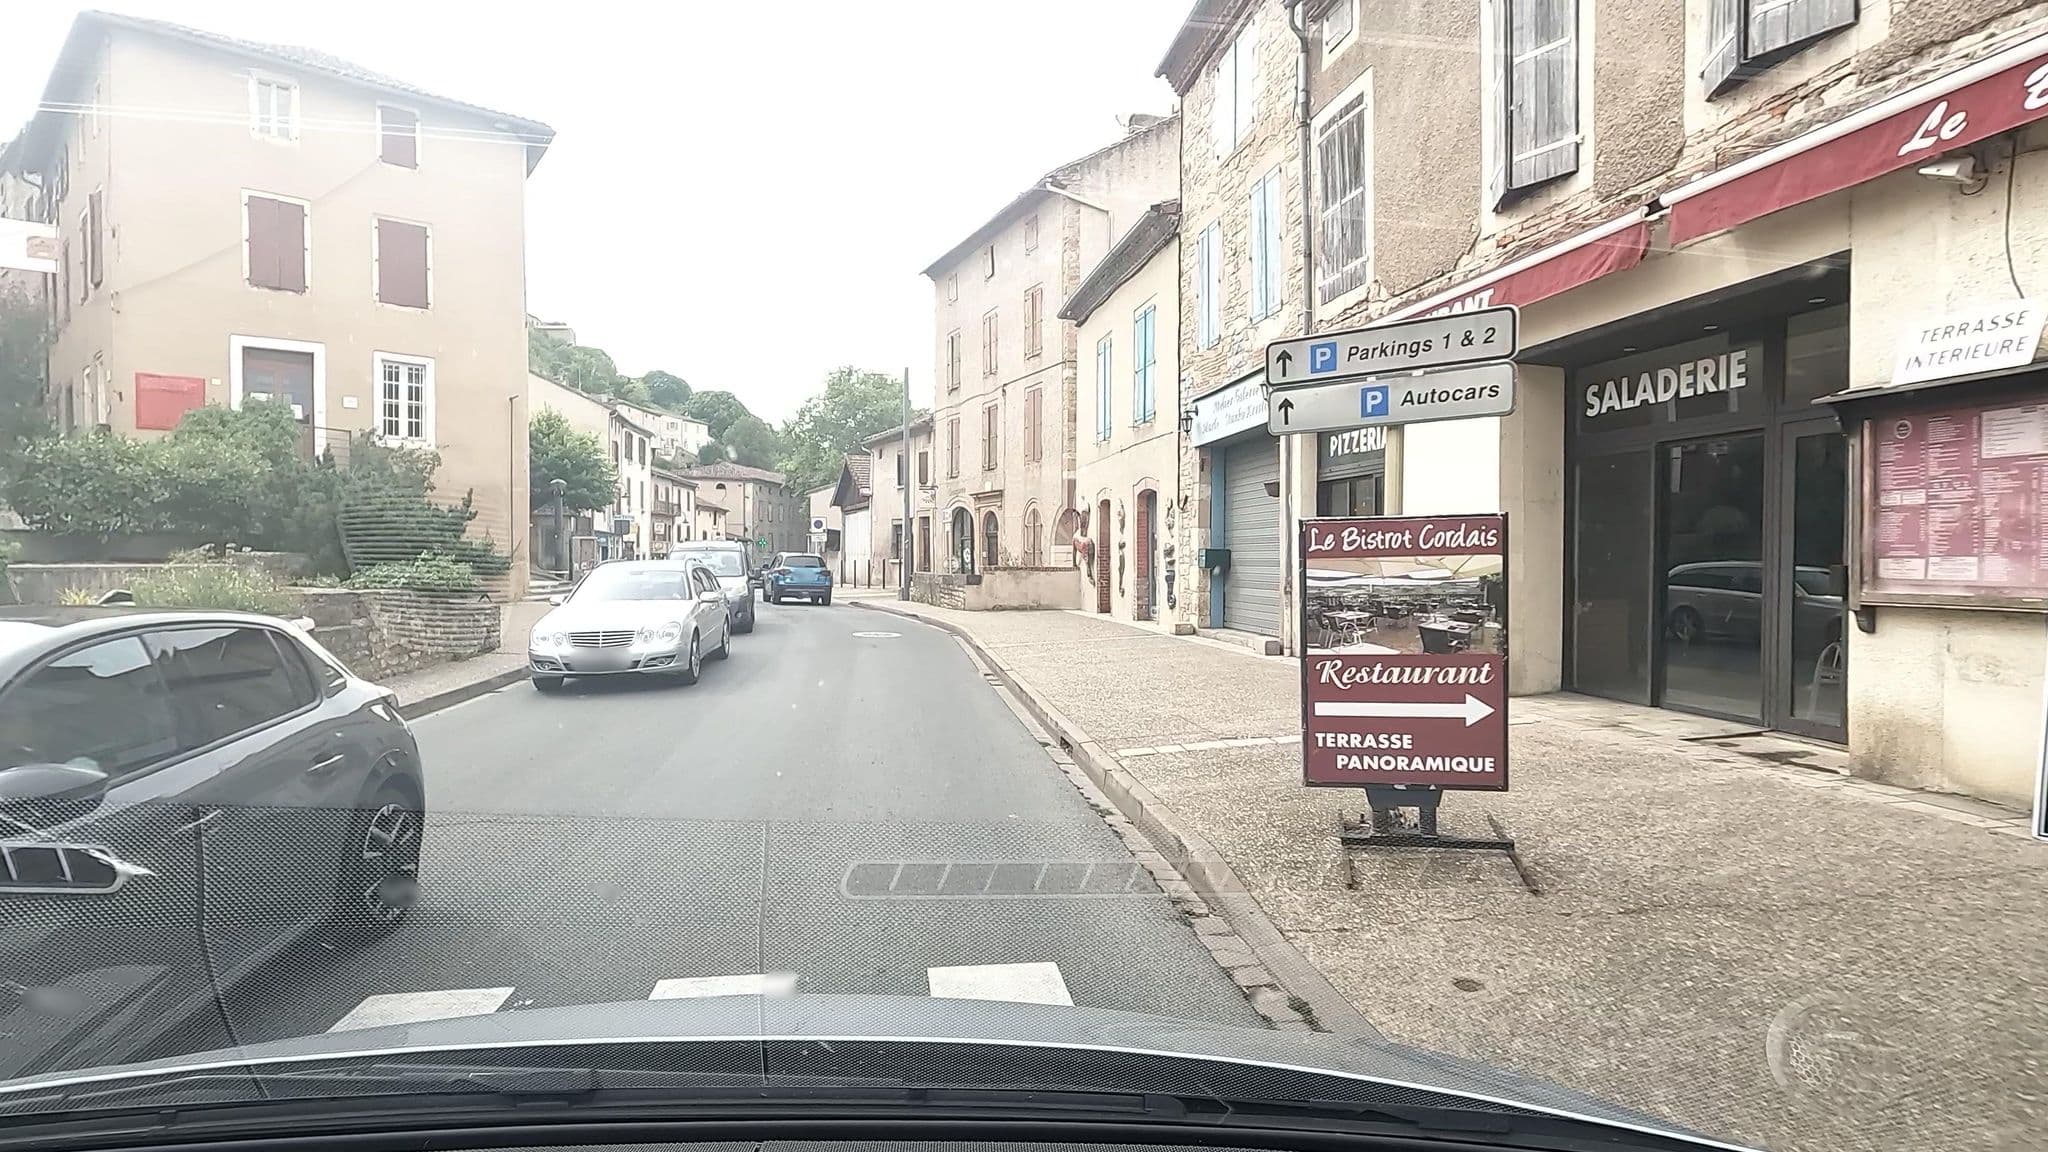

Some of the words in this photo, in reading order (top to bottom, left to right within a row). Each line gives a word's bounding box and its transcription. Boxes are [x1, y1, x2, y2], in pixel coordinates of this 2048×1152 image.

[1897, 100, 1968, 157] Le
[1920, 310, 2030, 344] TERRASSE
[1347, 337, 1433, 362] Parkings
[1442, 333, 1452, 350] 1
[1460, 330, 1475, 347] &
[1482, 327, 1496, 344] 2
[1905, 336, 2029, 371] INTERIEURE
[1400, 384, 1500, 407] Autocars
[1585, 350, 1747, 417] SALADERIE
[1308, 527, 1336, 552] Le
[1341, 526, 1413, 551] Bistrot
[1419, 522, 1498, 549] Cordais
[1315, 659, 1495, 690] Restaurant
[1314, 732, 1414, 750] TERRASSE
[1336, 754, 1495, 773] PANORAMIQUE
